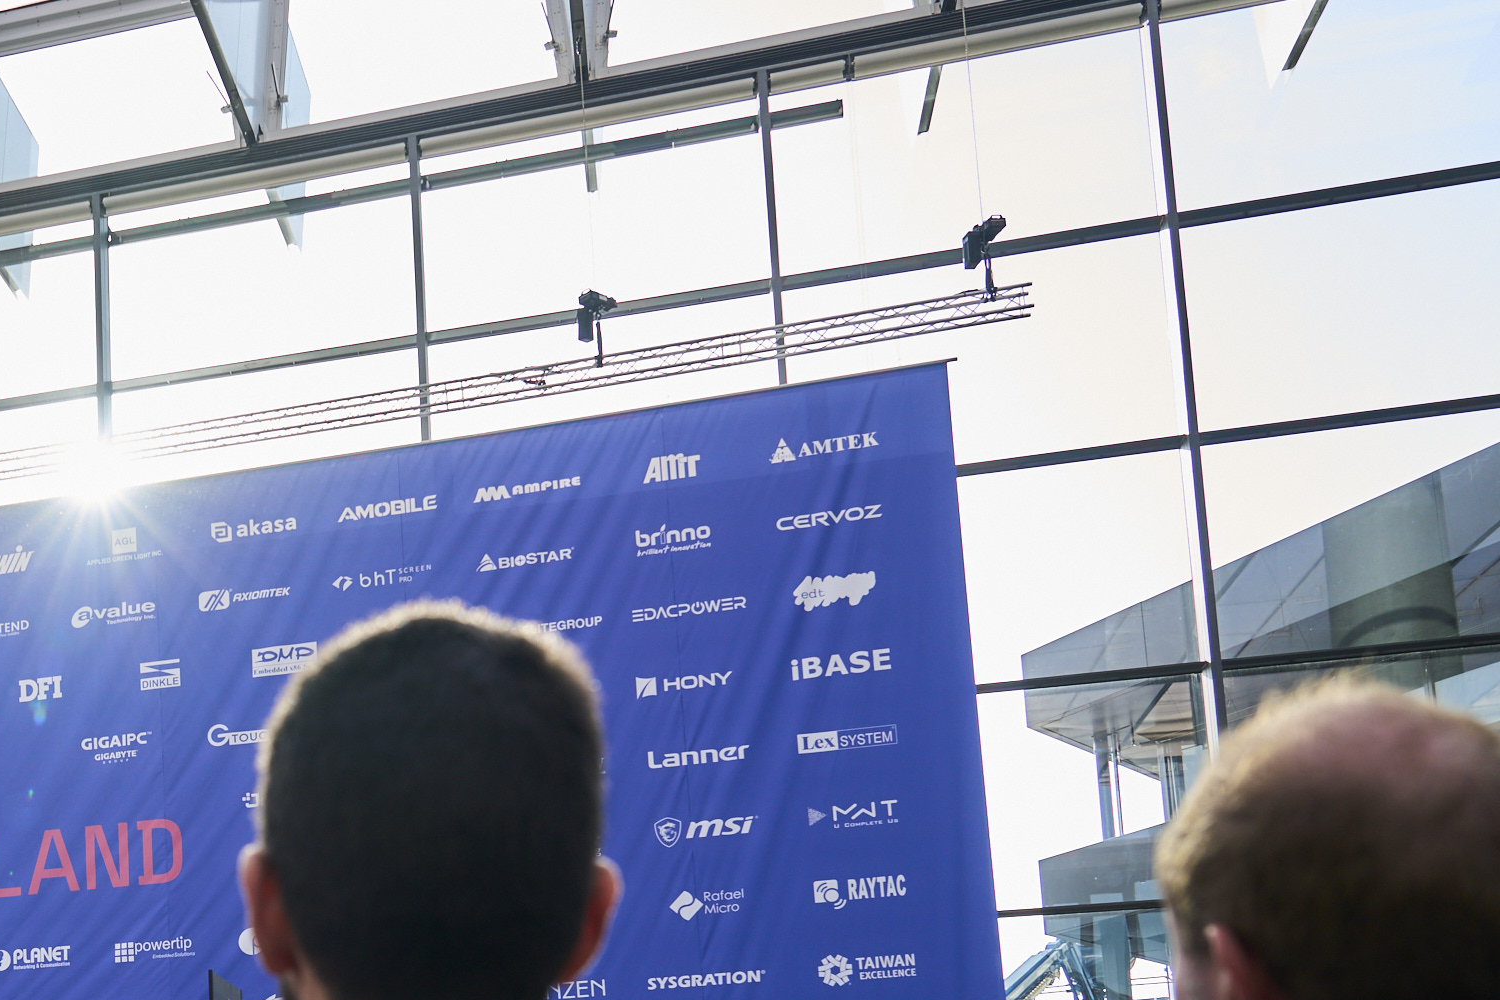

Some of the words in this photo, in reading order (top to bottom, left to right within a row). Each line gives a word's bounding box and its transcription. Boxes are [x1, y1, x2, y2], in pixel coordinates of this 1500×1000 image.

[798, 432, 879, 457] AMTEK
[338, 495, 437, 523] AMOBILE
[776, 505, 882, 530] CERVOZ
[236, 518, 296, 537] akasa
[635, 525, 711, 549] brinno
[231, 587, 290, 602] AXIOMTEK
[791, 648, 891, 681] iBASE
[19, 676, 62, 702] DFI
[142, 676, 180, 689] DINKLE
[663, 671, 732, 691] HONY
[81, 732, 149, 752] GIGAIPC
[802, 735, 835, 751] Lex
[839, 730, 893, 748] SYSTEM
[648, 745, 749, 768] Lanner
[703, 888, 745, 902] Rafael
[847, 875, 906, 900] RAYTAC
[704, 901, 740, 915] Micro
[13, 945, 71, 964] PLANET
[133, 937, 193, 956] powertip
[856, 953, 916, 970] TAIWAN
[647, 970, 761, 991] SYSGRATION
[859, 967, 917, 981] EXCELLENCE
